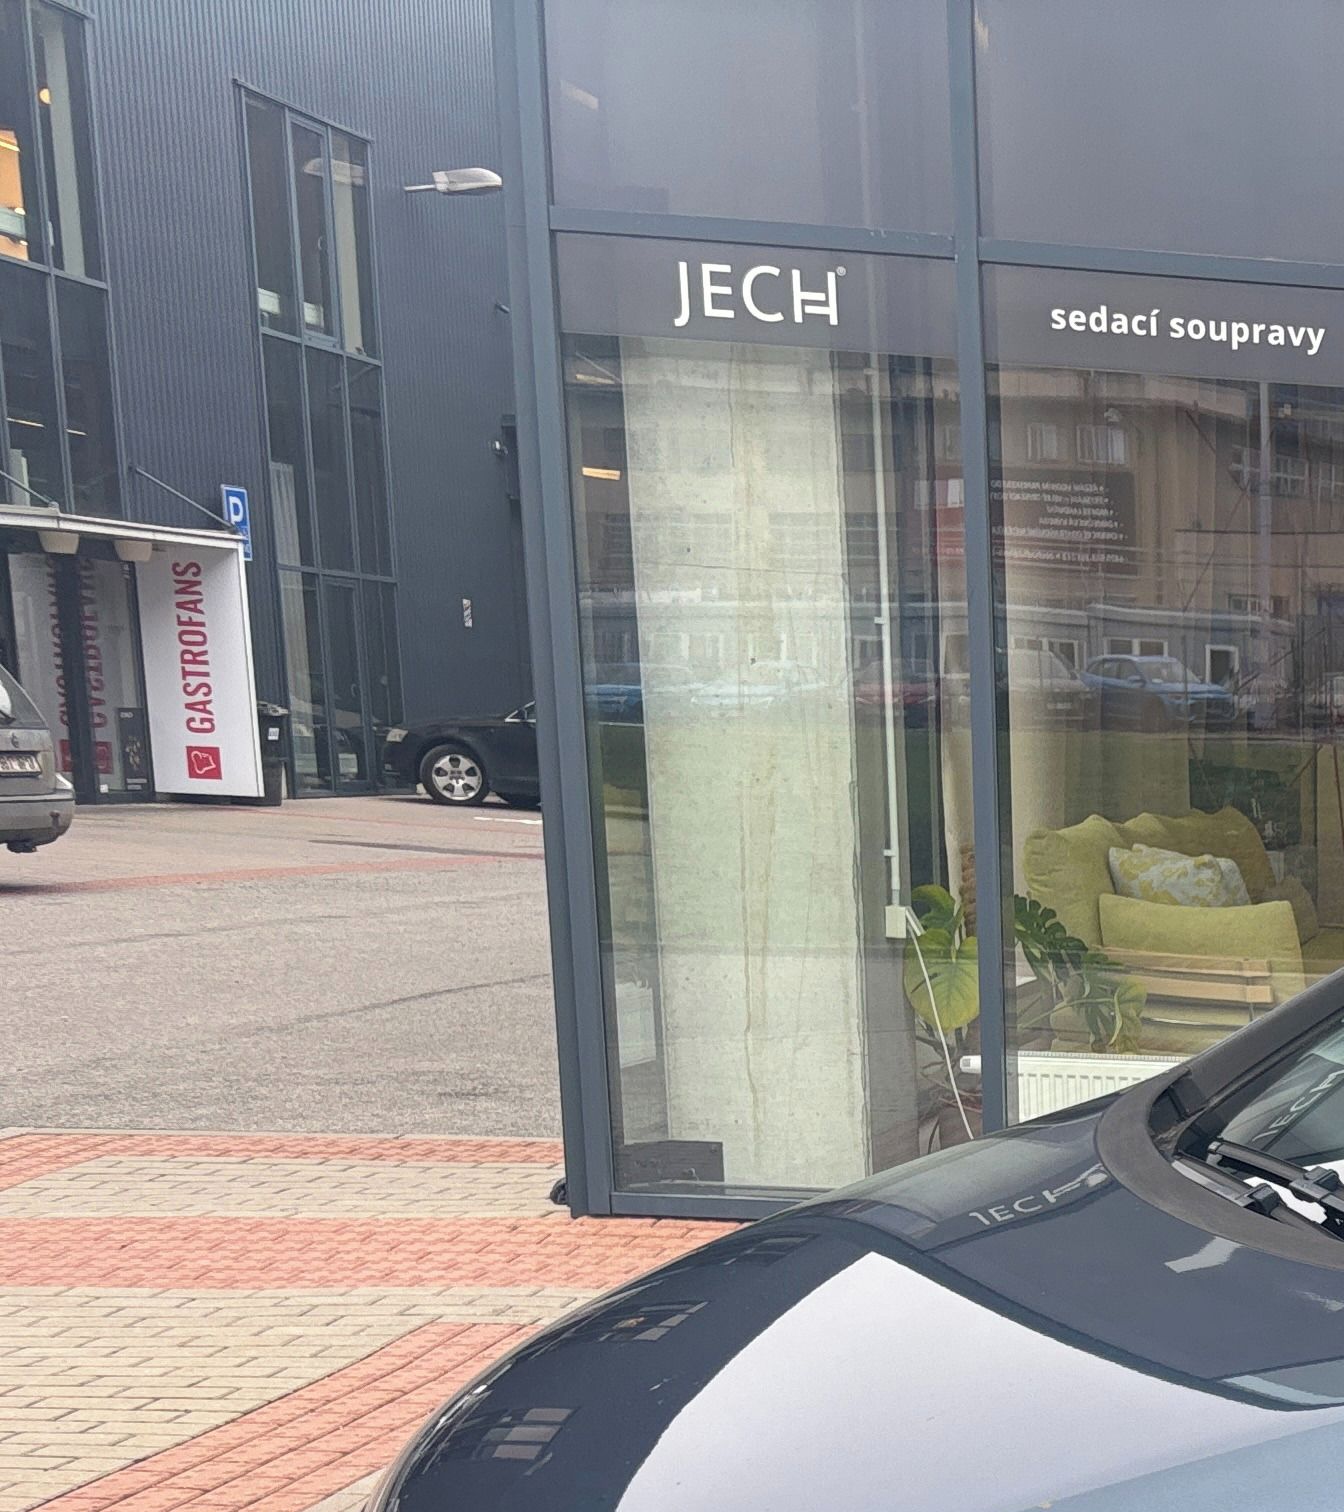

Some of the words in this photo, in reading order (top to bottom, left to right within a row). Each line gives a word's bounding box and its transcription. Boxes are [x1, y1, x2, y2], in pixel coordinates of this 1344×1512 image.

[1050, 304, 1160, 338] sedací
[1169, 317, 1326, 355] soupravy
[228, 495, 244, 526] P
[171, 561, 217, 735] GASTROFANS
